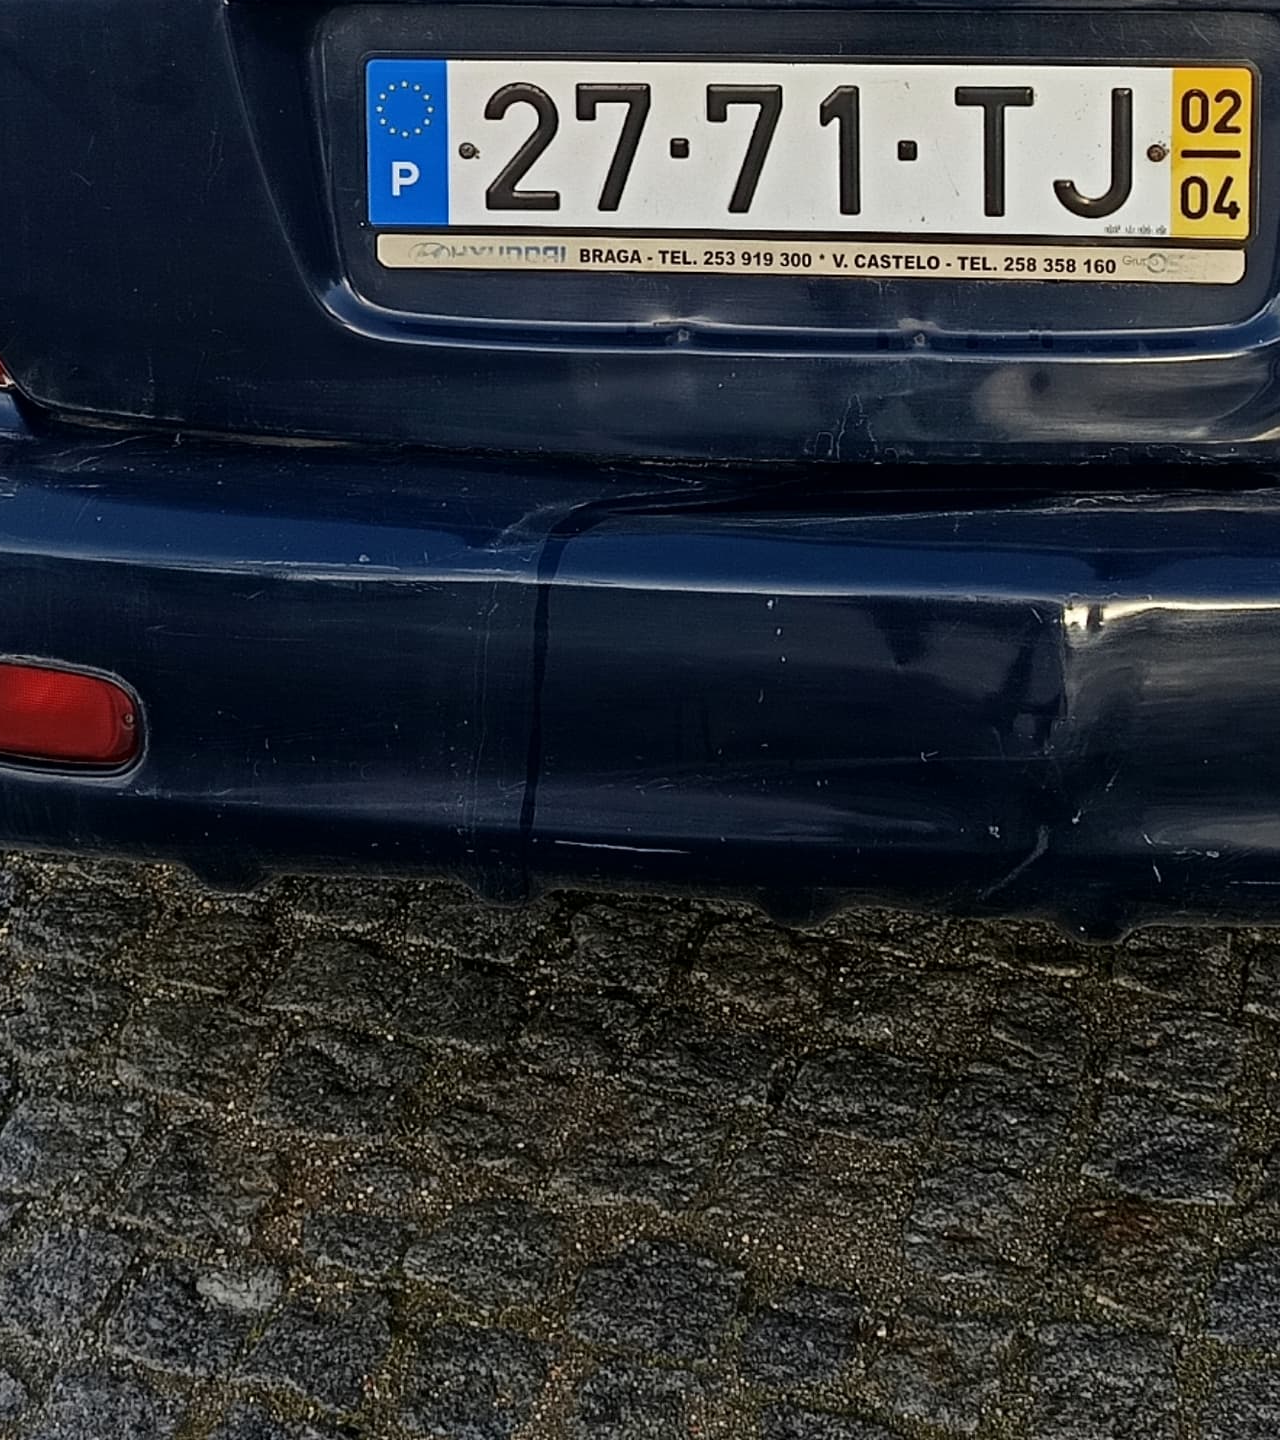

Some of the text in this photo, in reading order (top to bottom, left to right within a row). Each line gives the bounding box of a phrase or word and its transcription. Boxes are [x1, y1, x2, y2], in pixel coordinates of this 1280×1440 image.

[1180, 88, 1242, 134] 02
[391, 161, 420, 196] P
[1180, 175, 1241, 220] 04
[579, 248, 642, 264] BRAGA
[657, 249, 698, 266] TEL.
[703, 250, 736, 266] 253
[740, 251, 774, 267] 919
[779, 252, 812, 268] 300
[832, 253, 849, 269] V.
[854, 253, 941, 271] CASTELO
[956, 255, 998, 272] TEL.
[1003, 256, 1037, 273] 258
[1043, 257, 1077, 274] 358
[1083, 258, 1117, 274] 160
